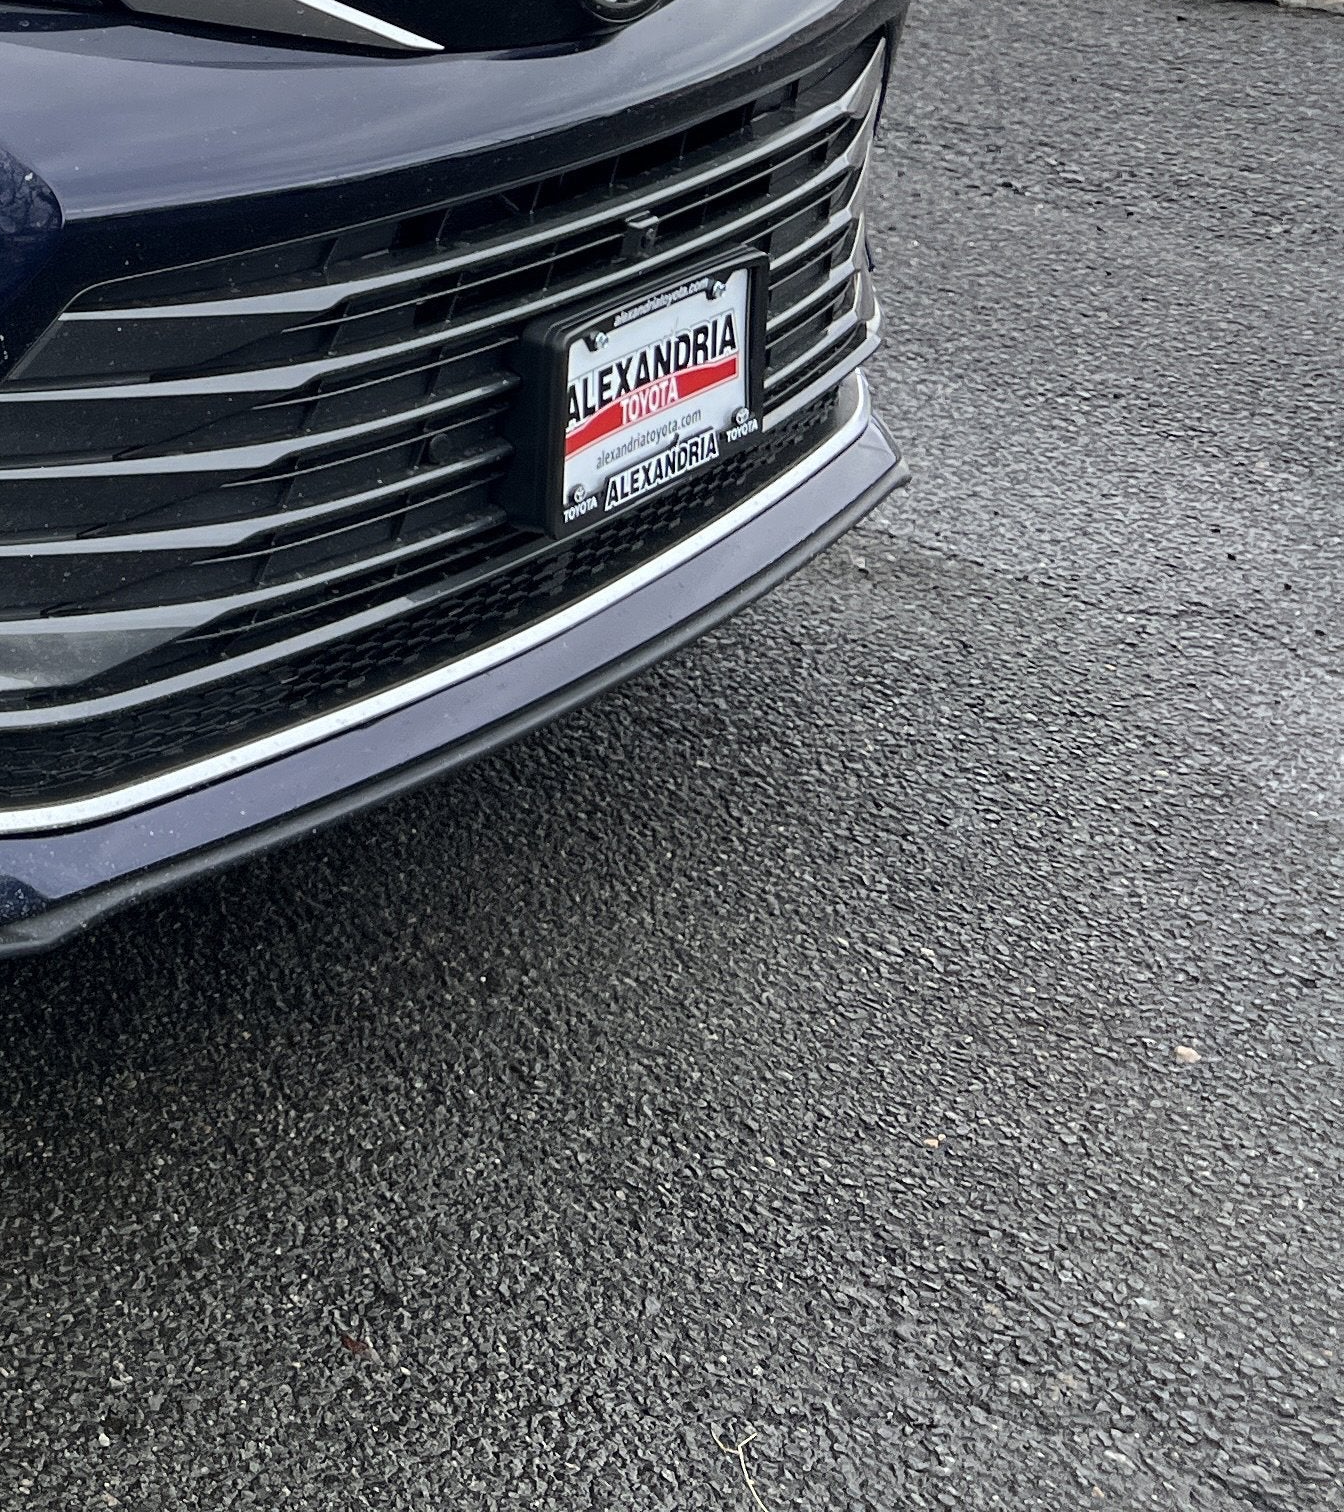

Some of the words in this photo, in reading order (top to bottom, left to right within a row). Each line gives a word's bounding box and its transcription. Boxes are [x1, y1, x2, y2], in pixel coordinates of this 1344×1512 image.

[567, 313, 737, 424] ALEXANDRIA
[620, 376, 679, 425] TOYOTA
[596, 409, 702, 469] alexandriatoyota.com
[726, 419, 758, 442] TOYOTA
[606, 431, 717, 508] ALEXANDRIA
[563, 496, 598, 523] TOYOTA
